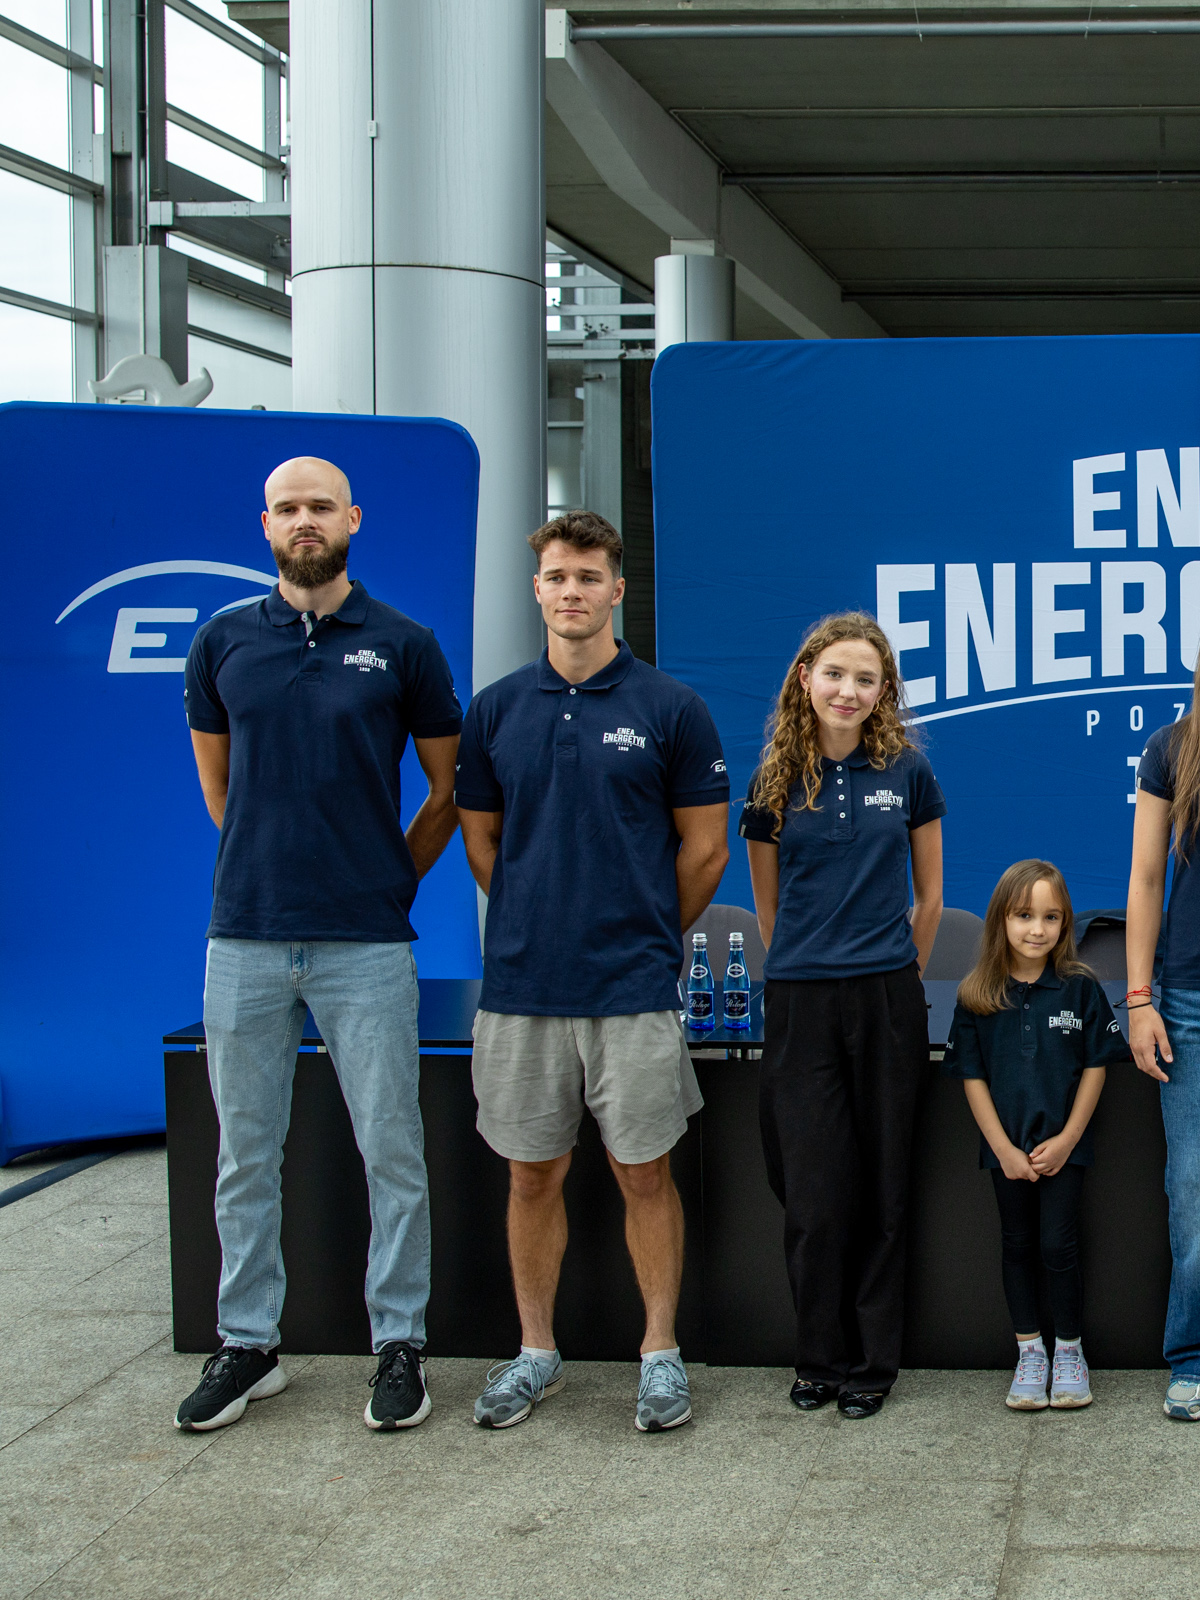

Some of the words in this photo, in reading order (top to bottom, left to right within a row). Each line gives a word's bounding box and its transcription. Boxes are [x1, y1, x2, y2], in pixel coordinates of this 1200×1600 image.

[358, 649, 376, 657] ENEA
[344, 654, 388, 669] ENERGETYK
[617, 727, 635, 736] ENEA
[603, 732, 646, 747] ENERGETYK
[876, 789, 893, 797] ENEA
[864, 795, 904, 808] ENERGETYK
[1060, 1010, 1075, 1018] ENEA
